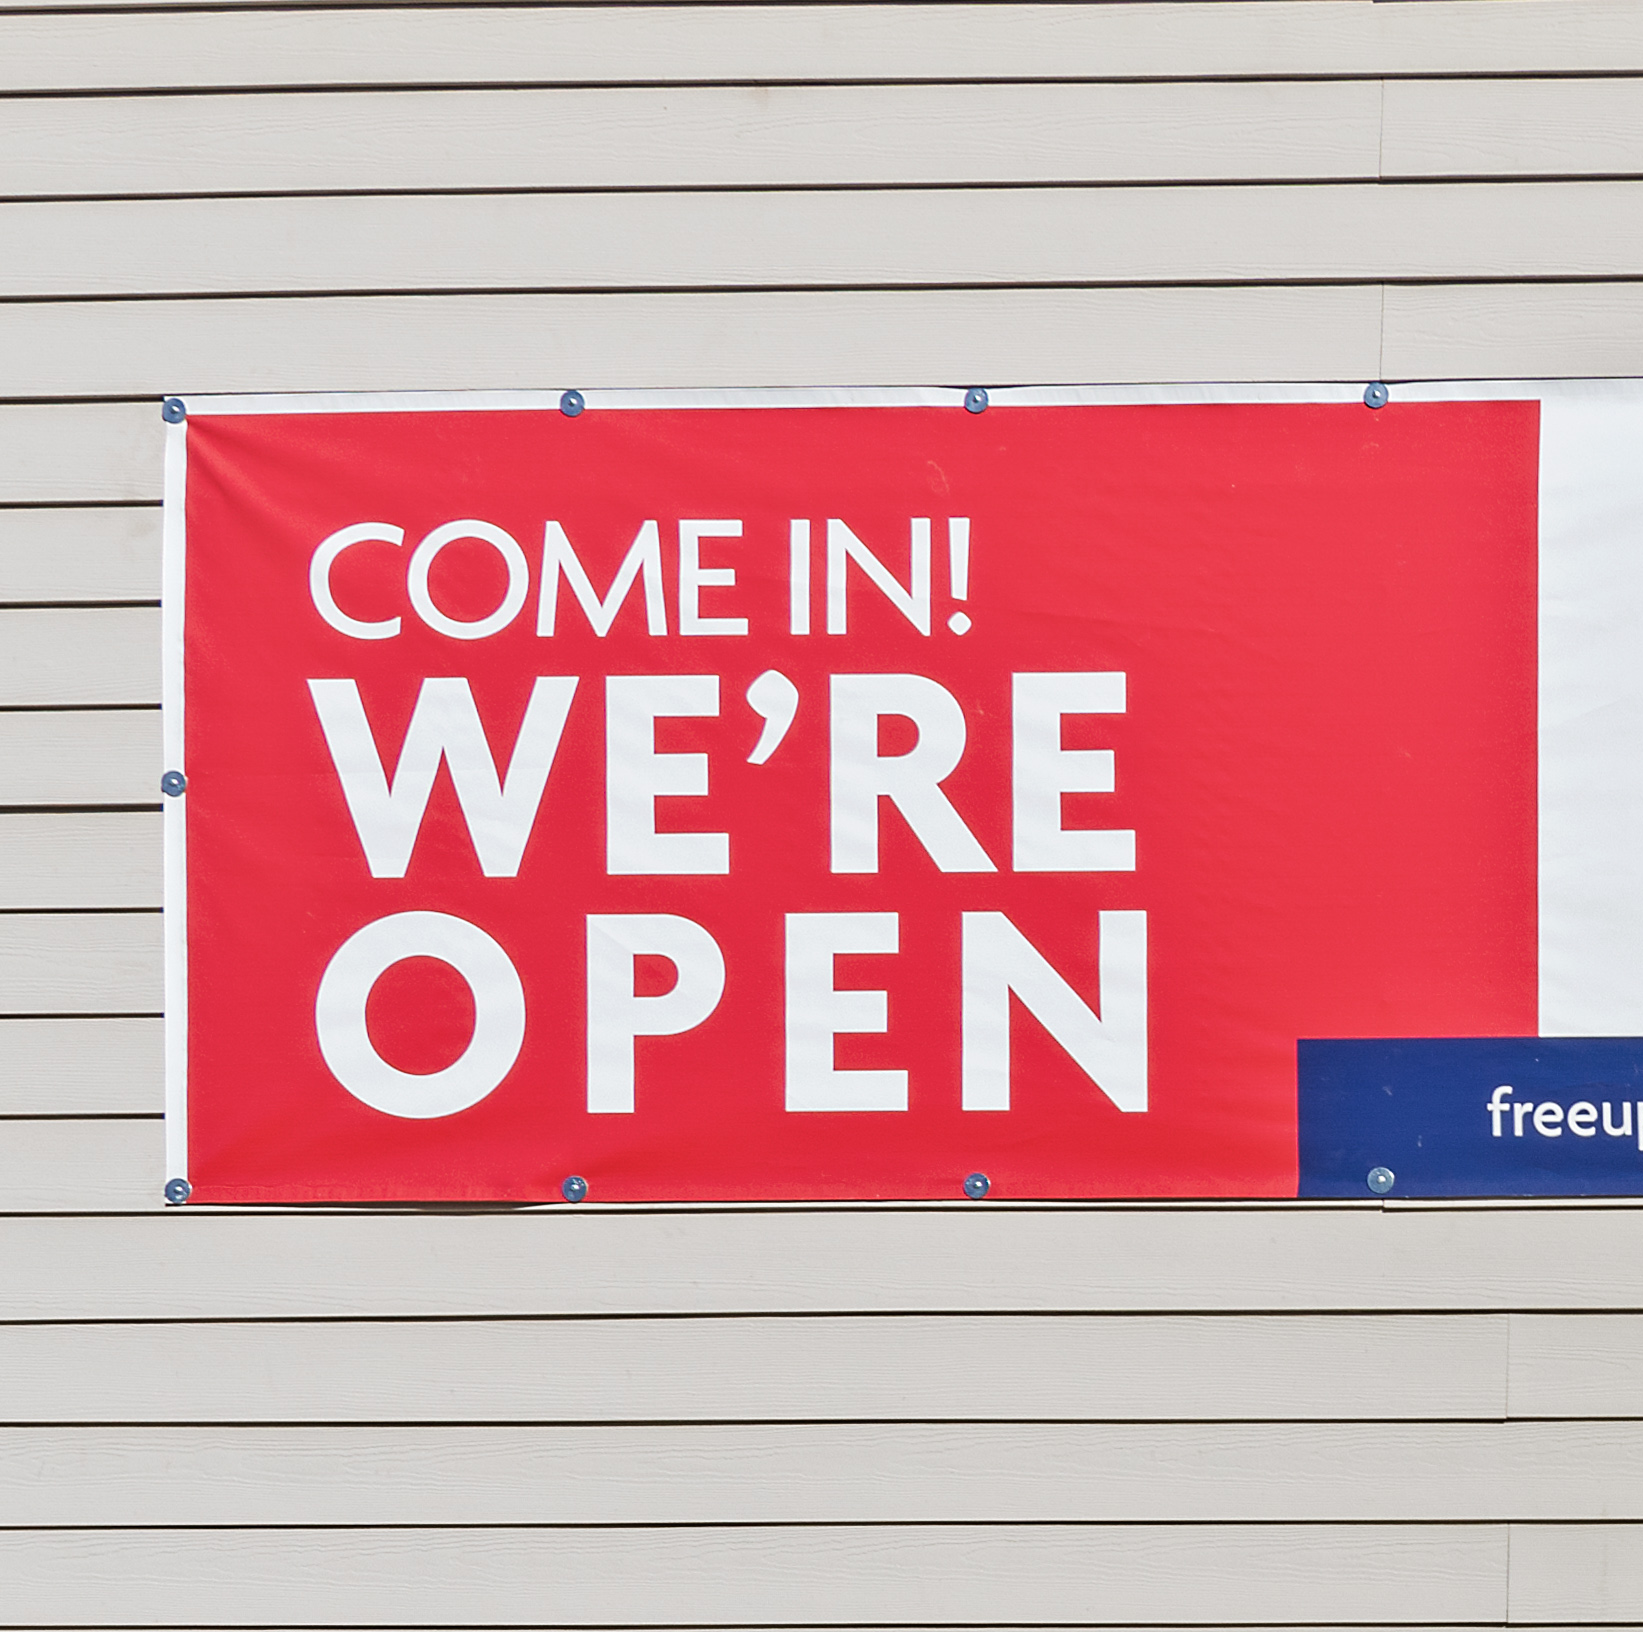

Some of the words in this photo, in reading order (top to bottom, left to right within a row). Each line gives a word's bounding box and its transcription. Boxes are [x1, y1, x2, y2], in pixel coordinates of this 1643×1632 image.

[309, 517, 748, 640] COME
[790, 516, 973, 637] IN!
[307, 668, 1136, 878] WE'RE
[315, 910, 1148, 1119] OPEN
